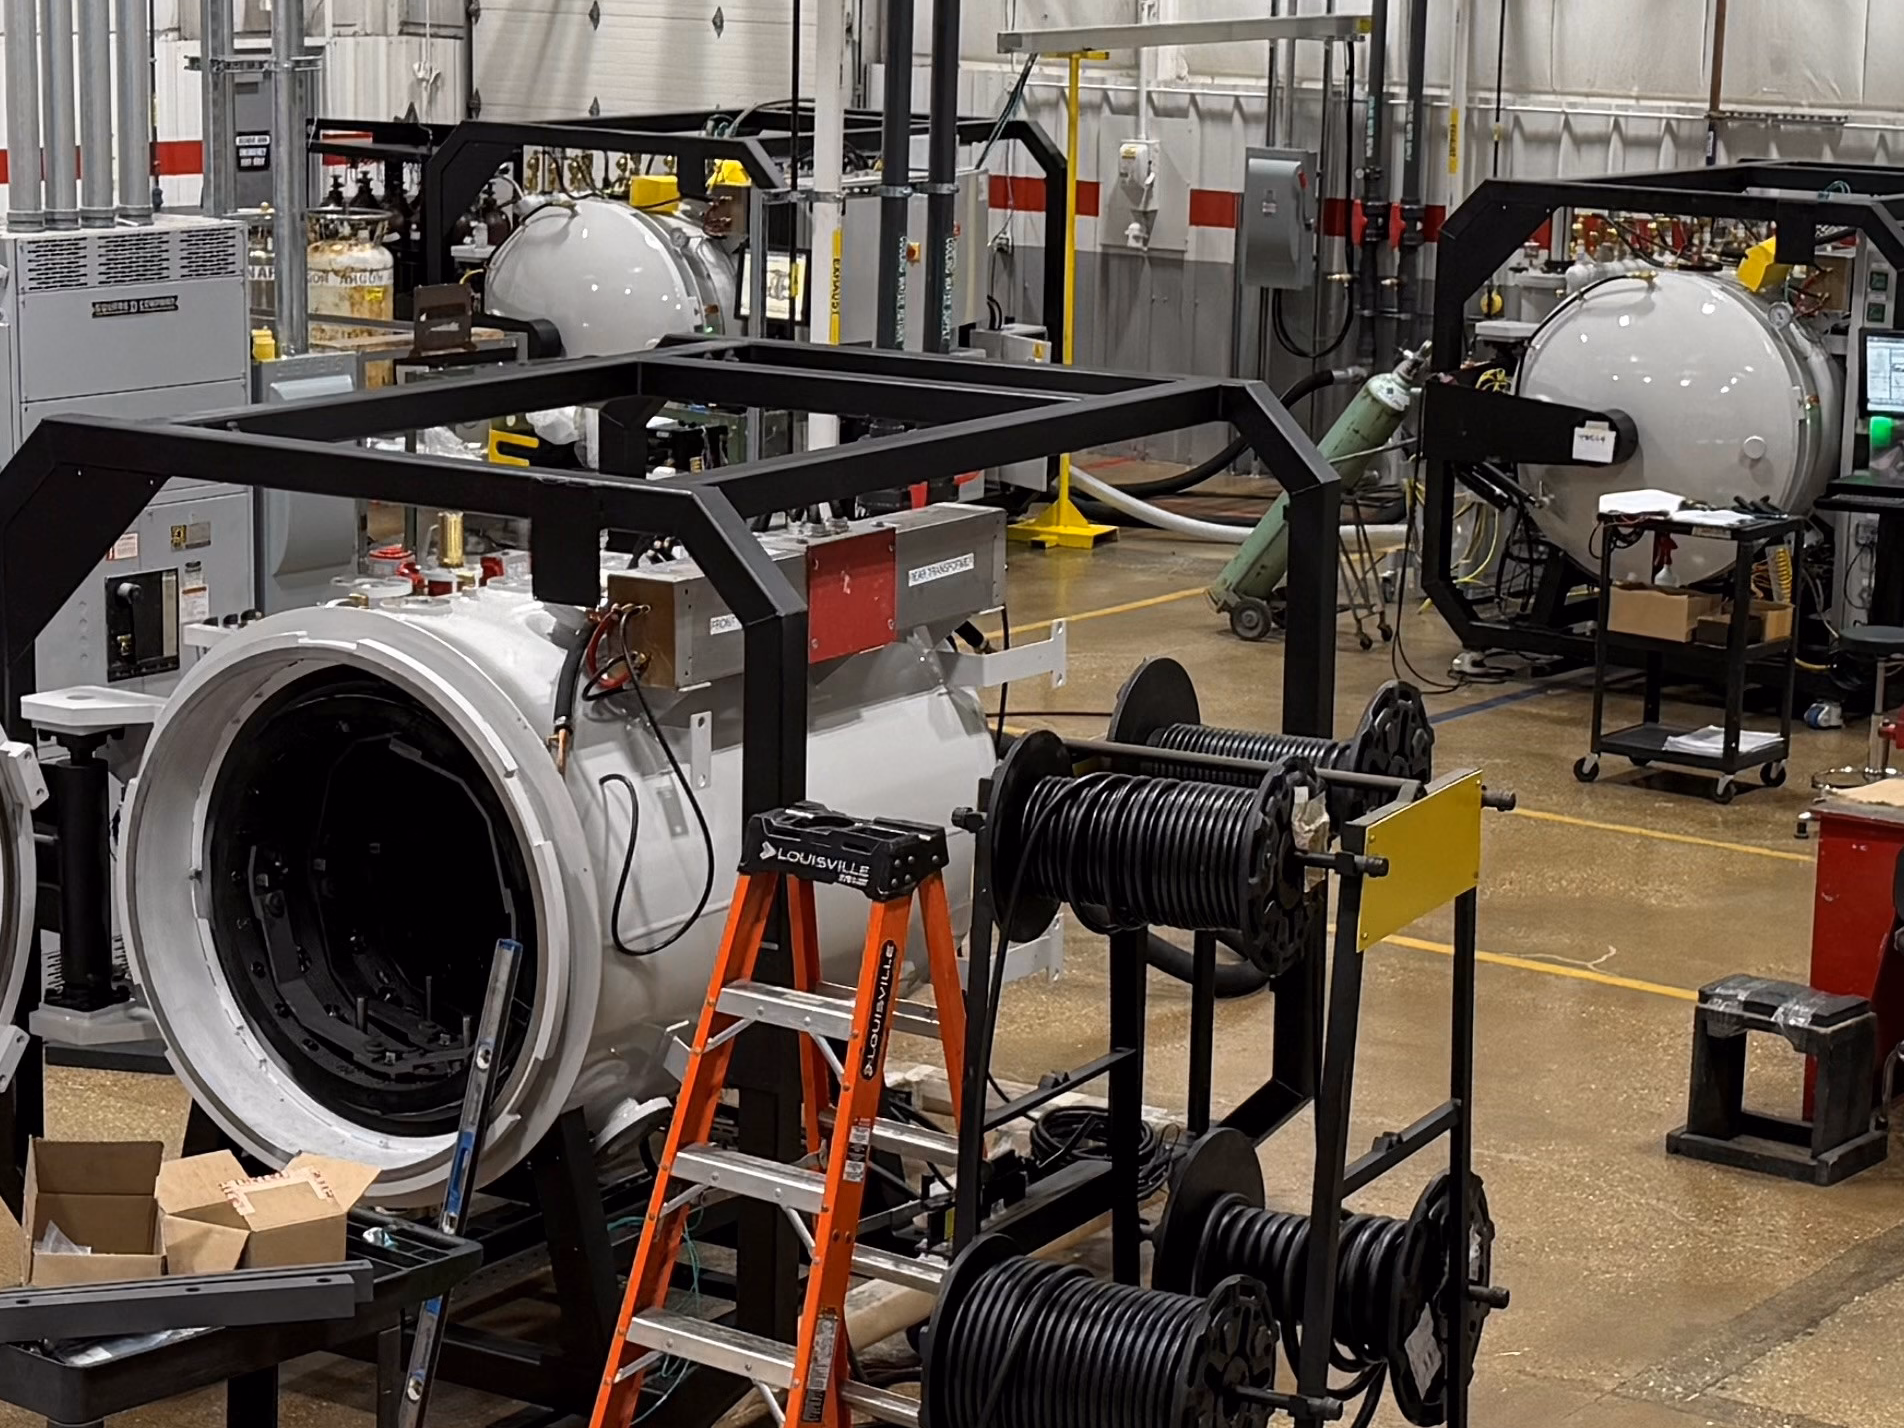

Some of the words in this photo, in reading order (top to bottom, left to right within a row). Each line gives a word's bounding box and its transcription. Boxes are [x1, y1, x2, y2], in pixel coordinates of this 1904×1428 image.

[831, 258, 841, 316] EXHAUST
[897, 276, 906, 307] WATER
[943, 277, 952, 307] WATER
[777, 847, 870, 878] LOUISVILLE
[868, 944, 895, 1060] LOUISVILLE
